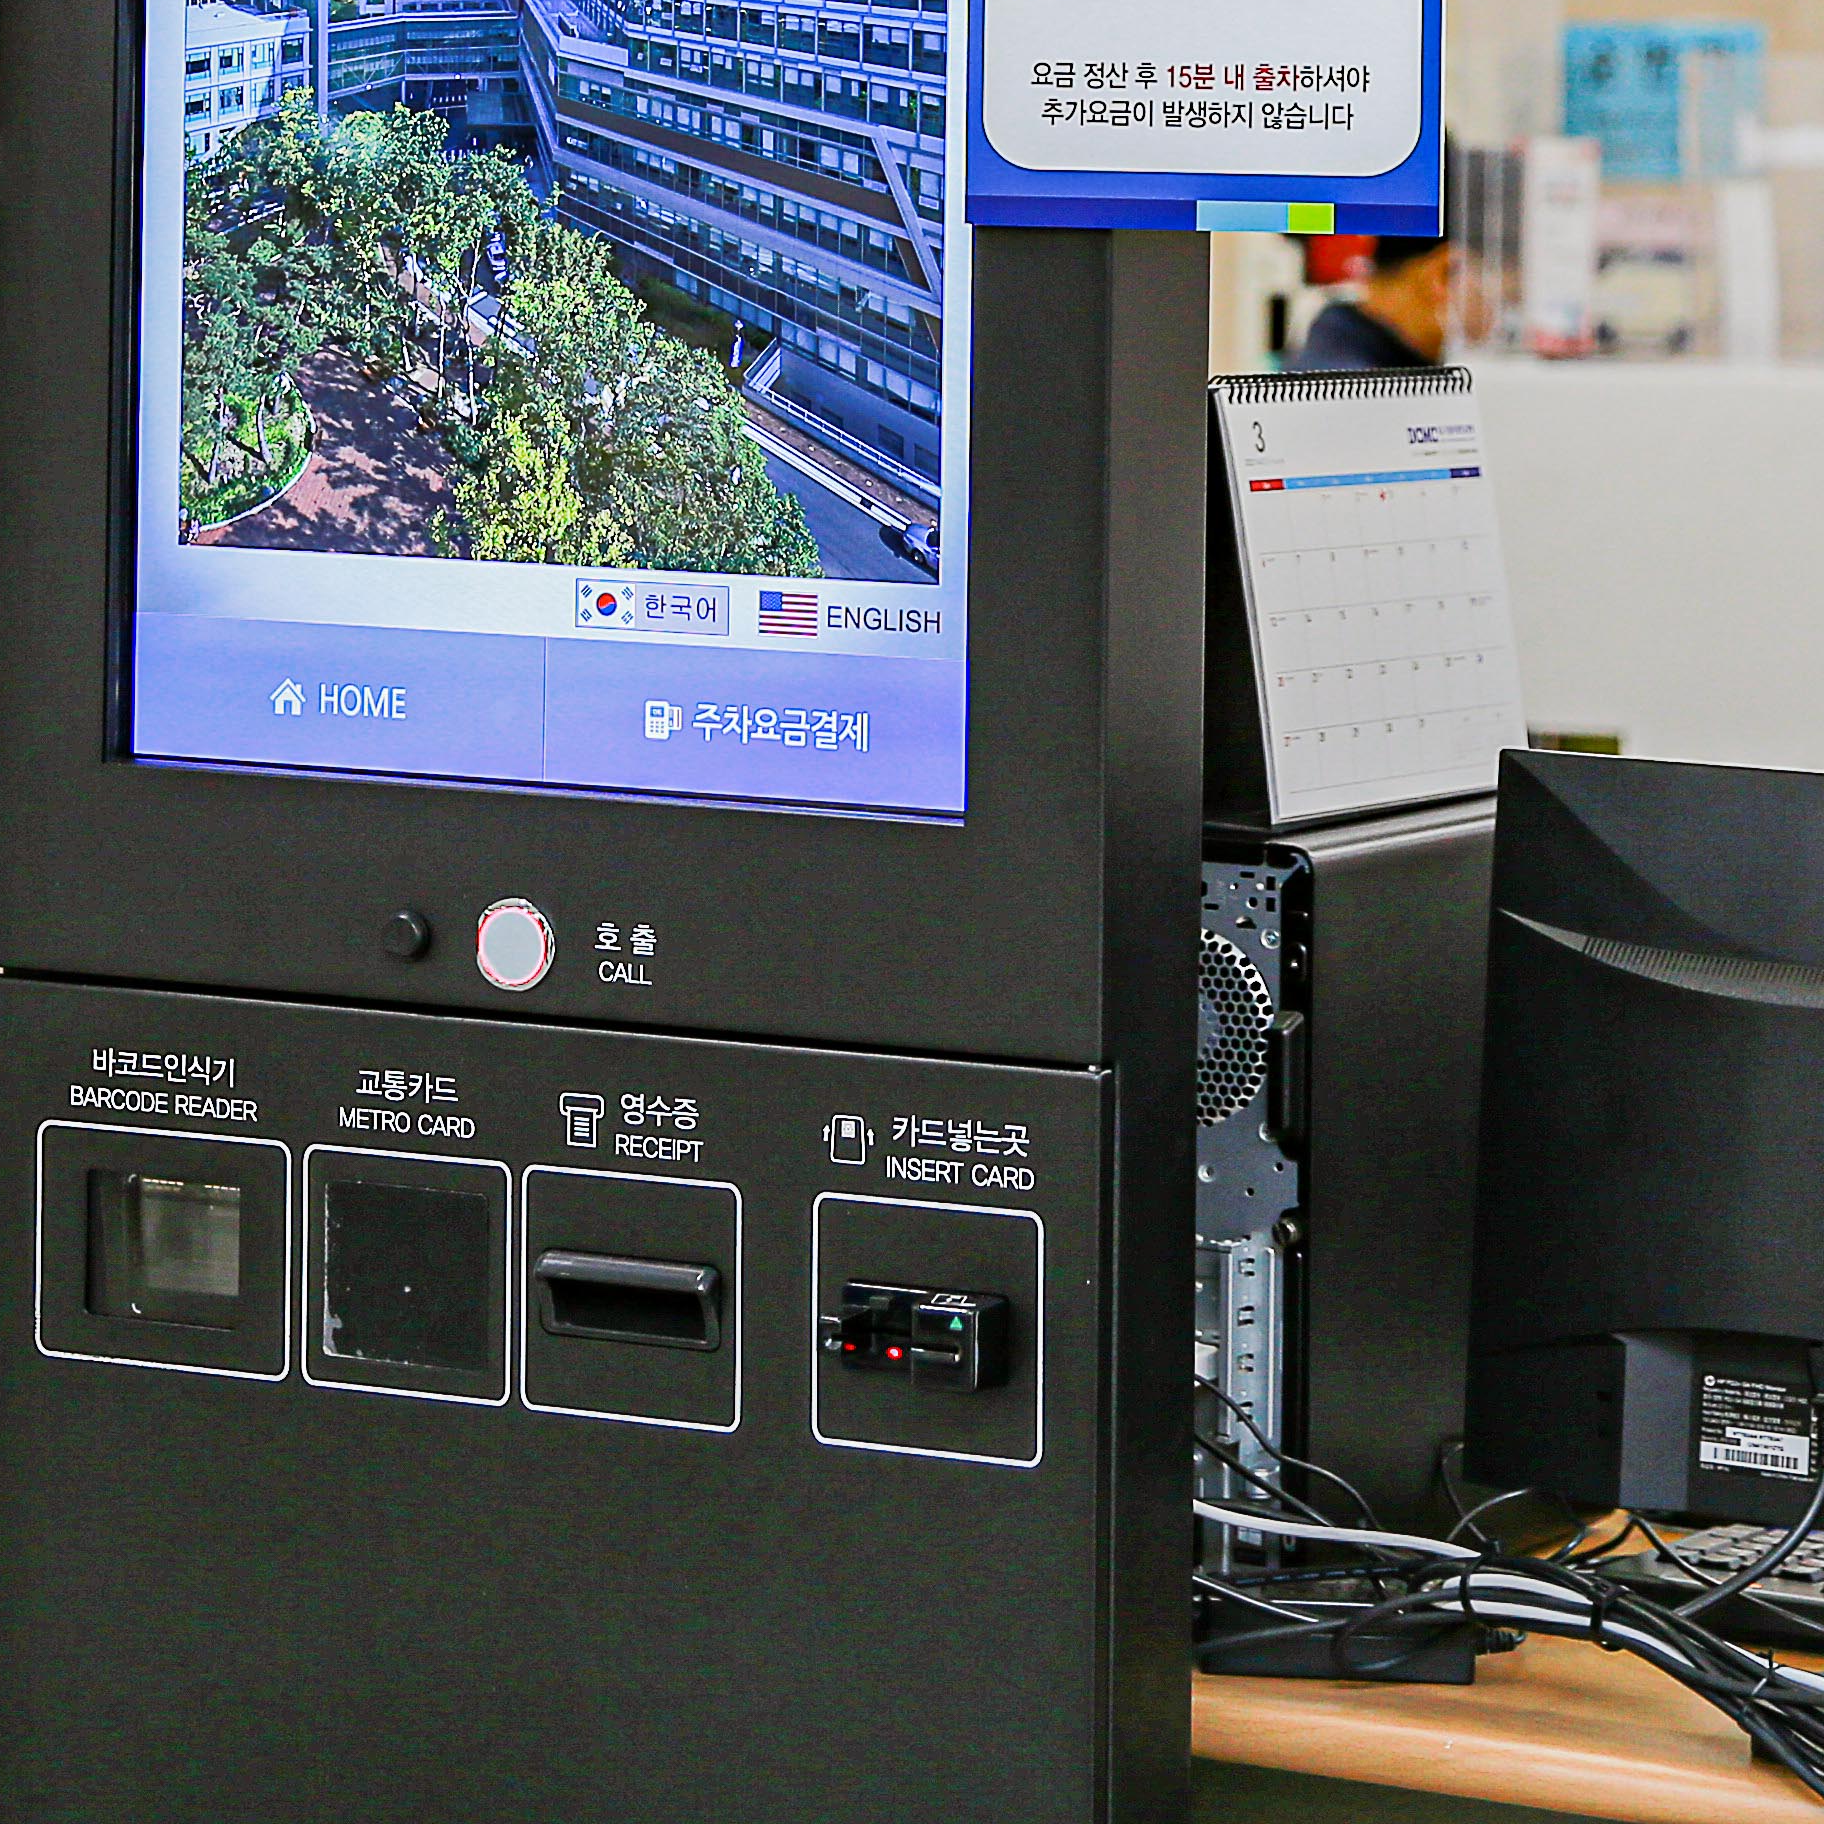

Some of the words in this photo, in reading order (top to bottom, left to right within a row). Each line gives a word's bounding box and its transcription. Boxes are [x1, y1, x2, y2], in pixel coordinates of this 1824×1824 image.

[1030, 62, 1076, 89] 요금
[1083, 61, 1129, 90] 정산
[1134, 62, 1158, 90] 후
[1167, 63, 1216, 90] 15분
[1224, 63, 1245, 91] 내
[1252, 63, 1370, 93] 출차하셔야
[1041, 98, 1154, 128] 추가요금이
[1162, 100, 1253, 129] 발생하지
[1261, 101, 1355, 131] 않습니다
[1252, 420, 1266, 454] 3
[645, 594, 716, 623] 한국어
[827, 605, 941, 634] ENGLISH
[317, 681, 406, 719] HOME
[691, 701, 871, 753] 주차요금결제
[598, 960, 653, 986] CALL
[92, 1047, 235, 1089] 바코드인식기
[70, 1084, 169, 1114] BARCODE
[174, 1094, 258, 1123] READER
[355, 1069, 459, 1104] 교통카드
[339, 1106, 411, 1134] METRO
[417, 1113, 476, 1139] CARD
[620, 1093, 700, 1130] 영수증
[615, 1133, 705, 1163] RECEIPT
[892, 1114, 1030, 1158] 카드넣는곳
[886, 1155, 959, 1185] INSERT
[953, 1161, 1035, 1191] CARD
